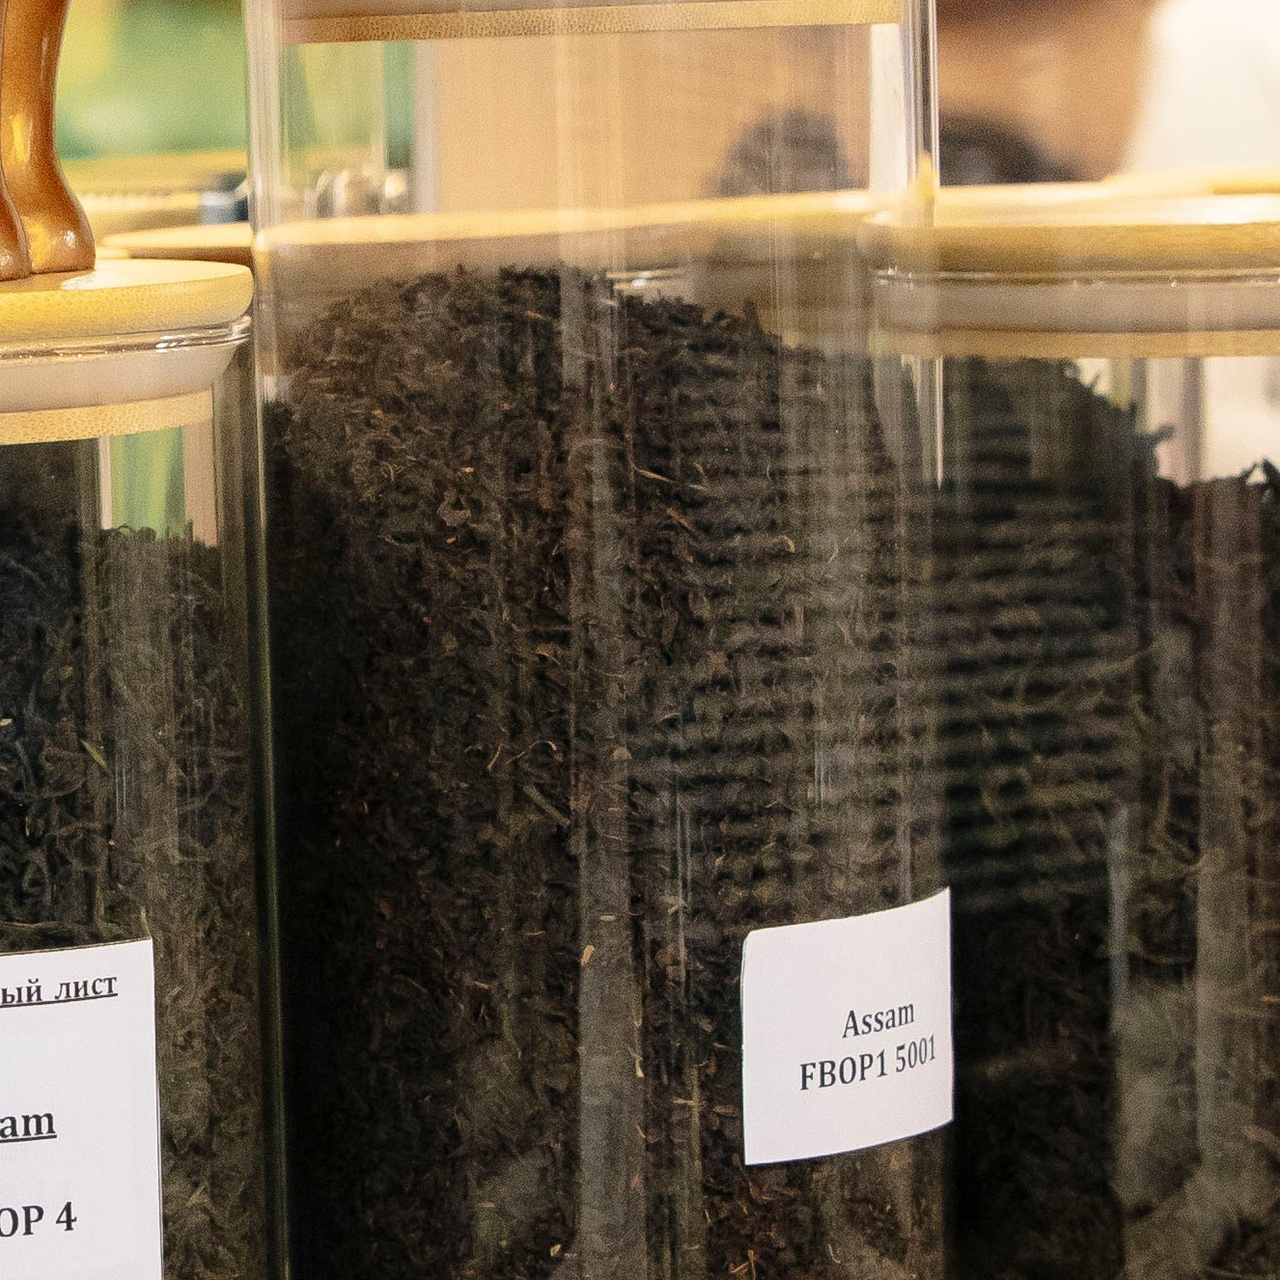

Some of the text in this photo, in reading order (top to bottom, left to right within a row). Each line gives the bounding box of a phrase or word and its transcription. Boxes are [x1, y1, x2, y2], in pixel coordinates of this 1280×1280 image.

[54, 974, 119, 1000] лист
[842, 1003, 915, 1039] Assam
[799, 1035, 937, 1091] FBOP1 5001
[55, 1200, 78, 1232] 4
